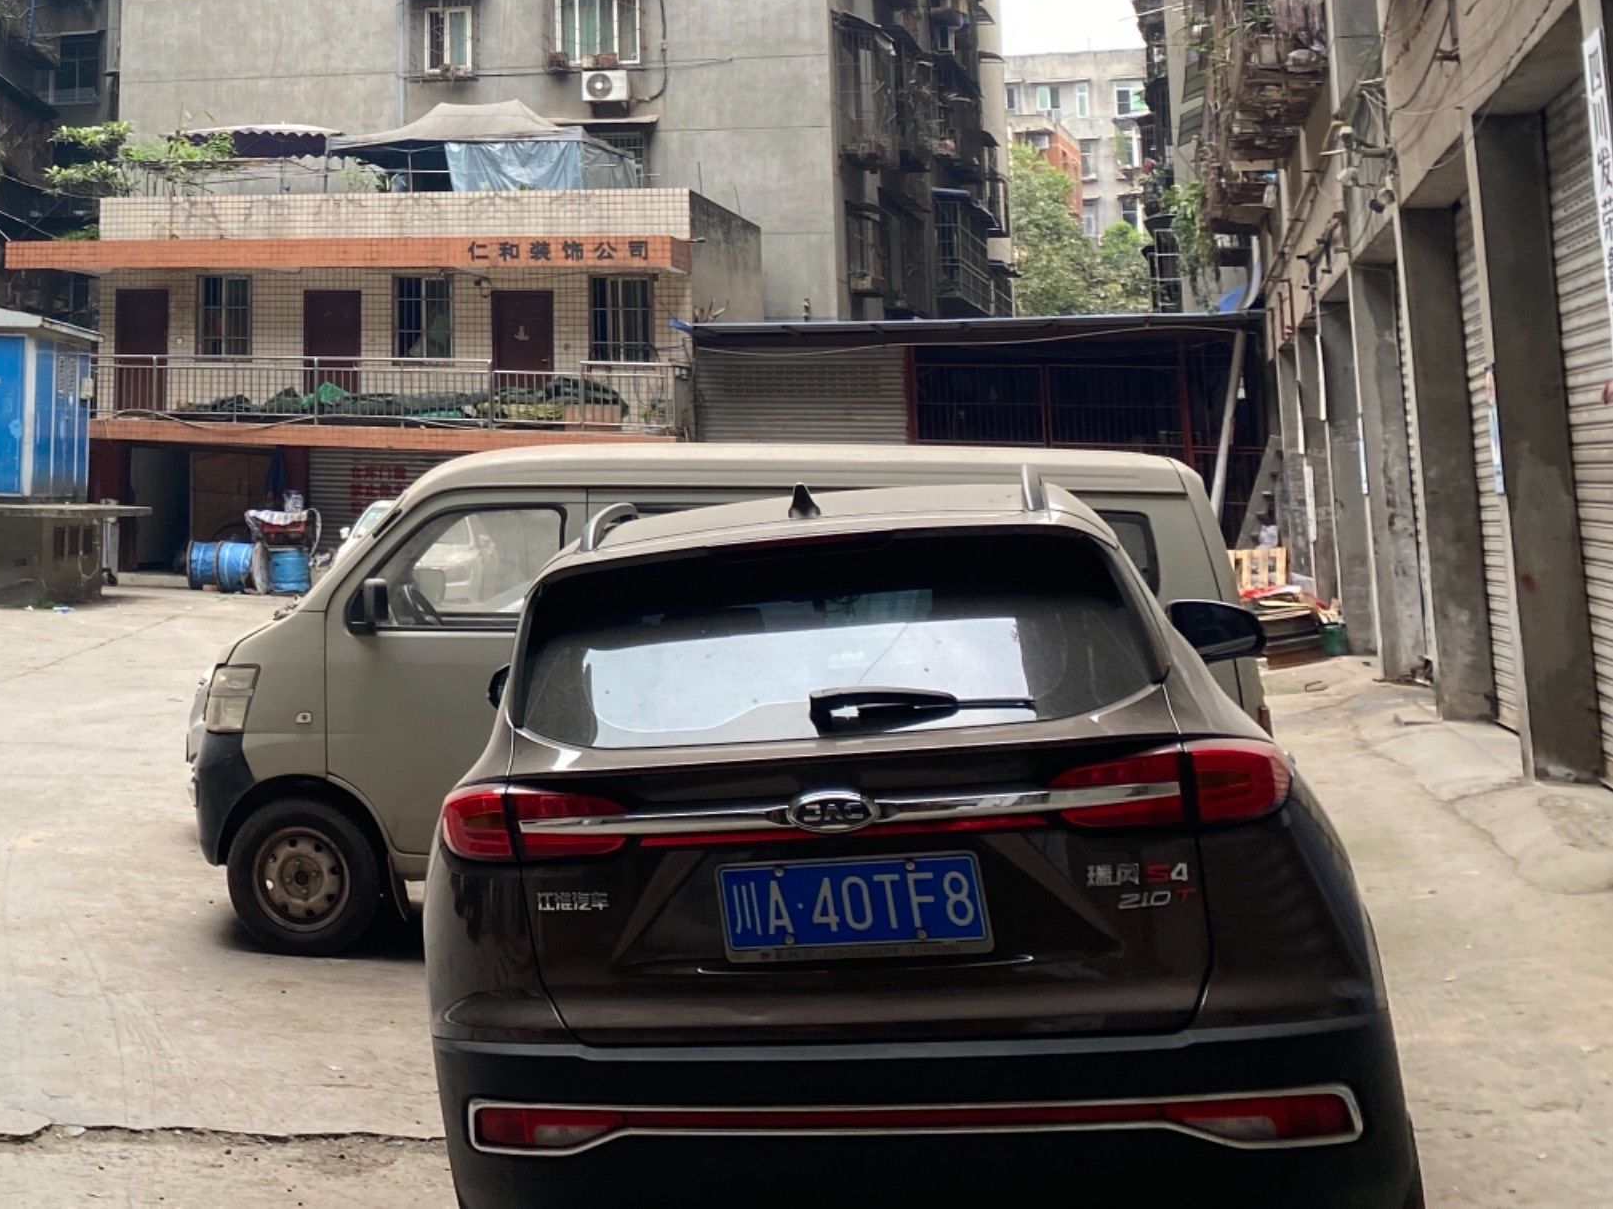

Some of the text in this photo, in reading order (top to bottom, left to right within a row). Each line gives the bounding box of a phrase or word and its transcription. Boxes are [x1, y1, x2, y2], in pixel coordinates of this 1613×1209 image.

[468, 241, 648, 261] 仁和装饰公司
[536, 891, 610, 911] 江淮汽车
